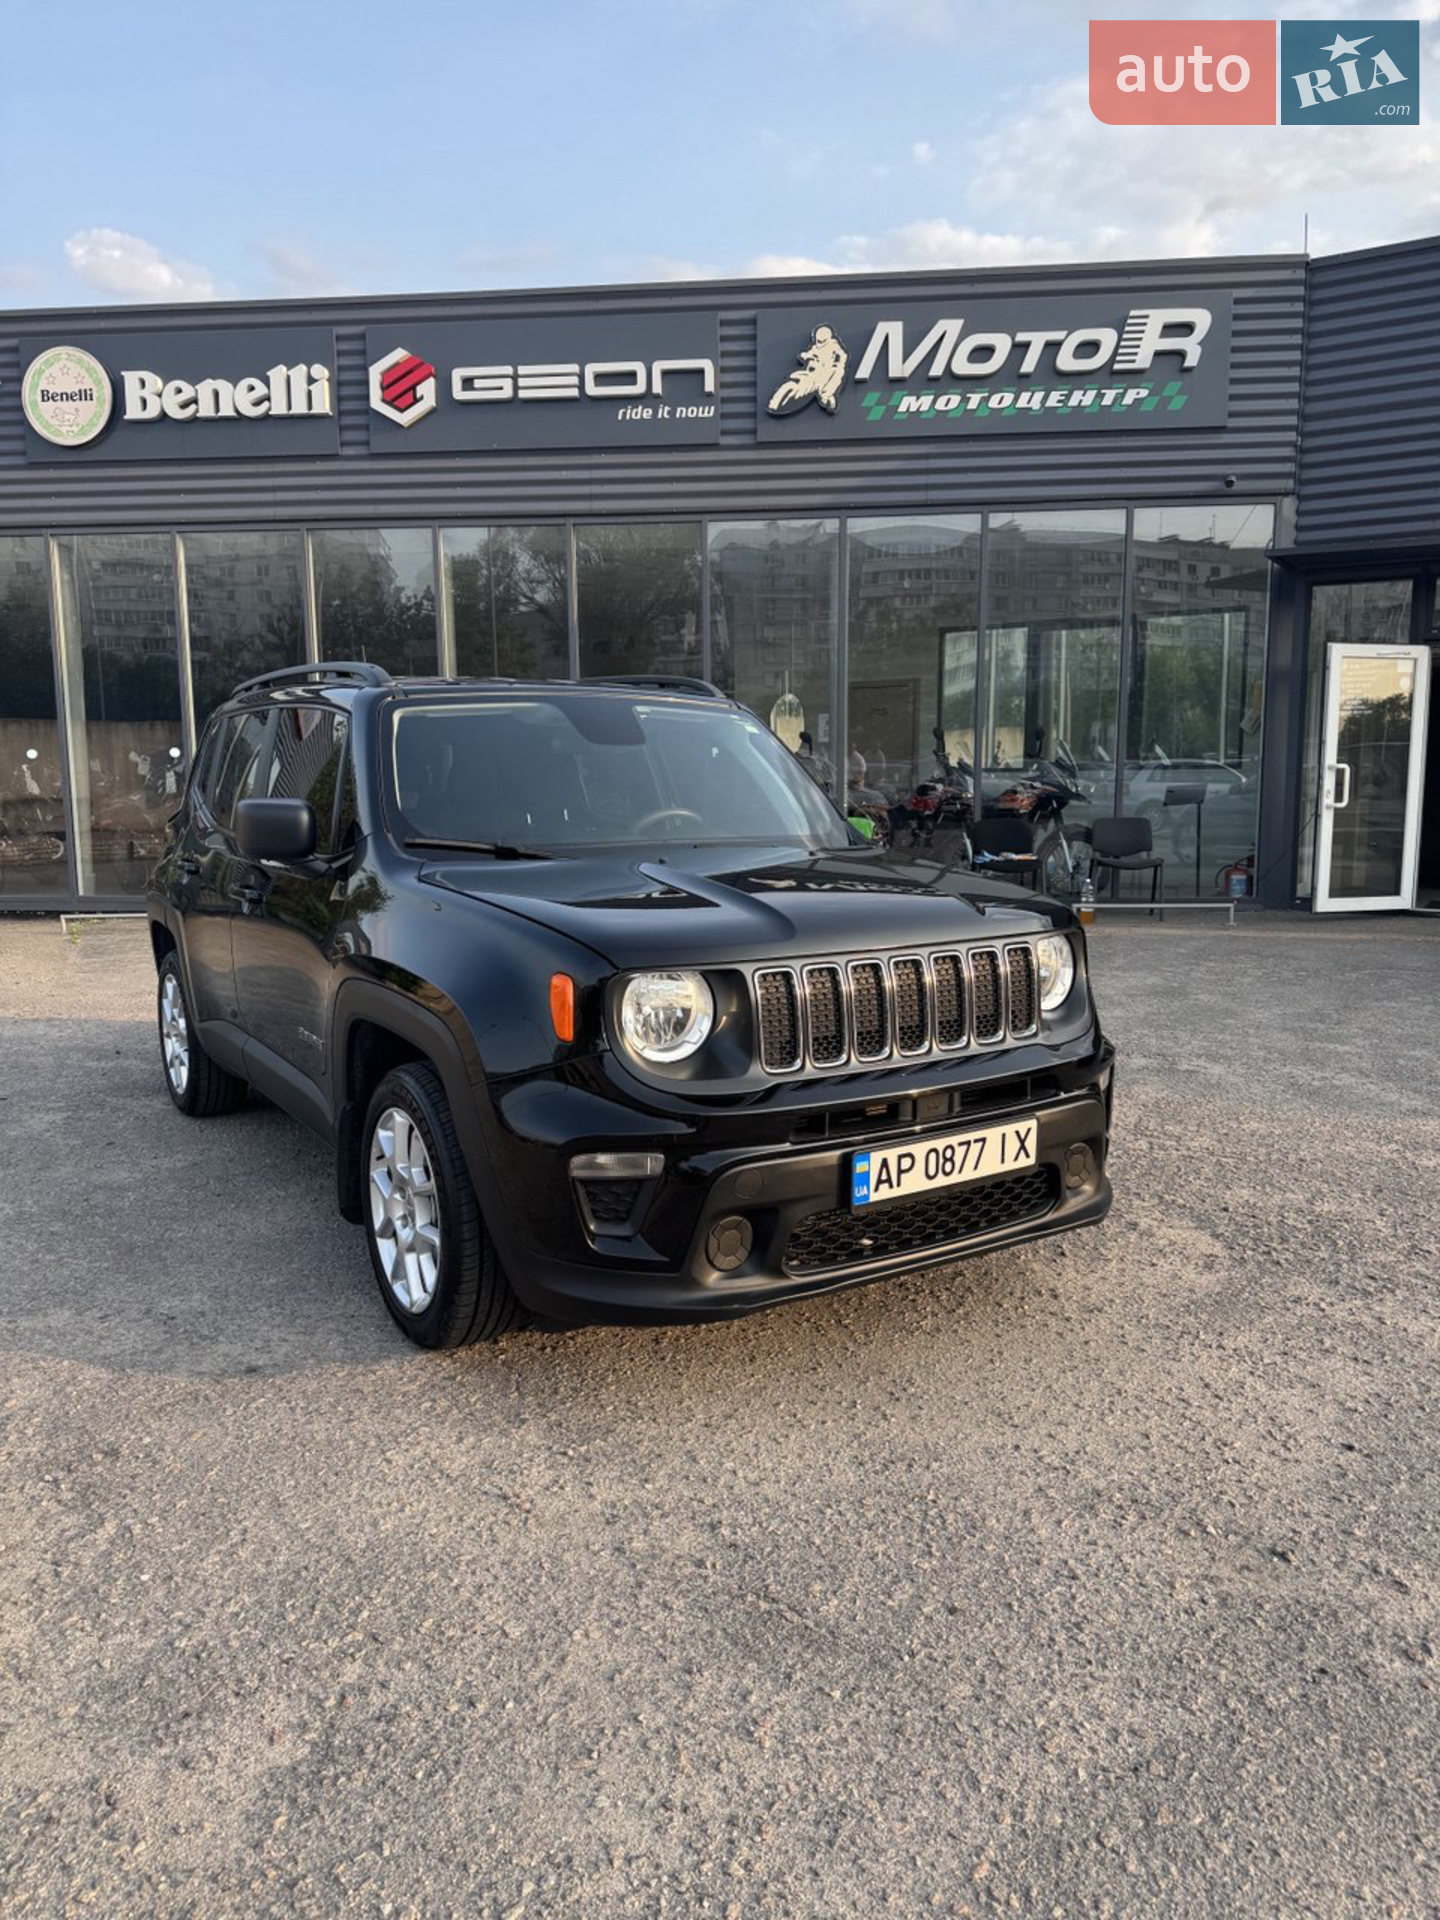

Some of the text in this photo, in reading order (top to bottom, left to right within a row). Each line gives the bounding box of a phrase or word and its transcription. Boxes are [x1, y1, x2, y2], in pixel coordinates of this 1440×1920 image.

[120, 363, 333, 422] Benelli
[451, 358, 715, 401] GEON
[40, 387, 94, 404] Benelli
[897, 387, 1151, 414] МОТОЦЕНТР
[617, 404, 716, 421] ride it now
[873, 1151, 916, 1194] AP
[924, 1136, 988, 1181] 0877
[854, 1184, 869, 1198] UA
